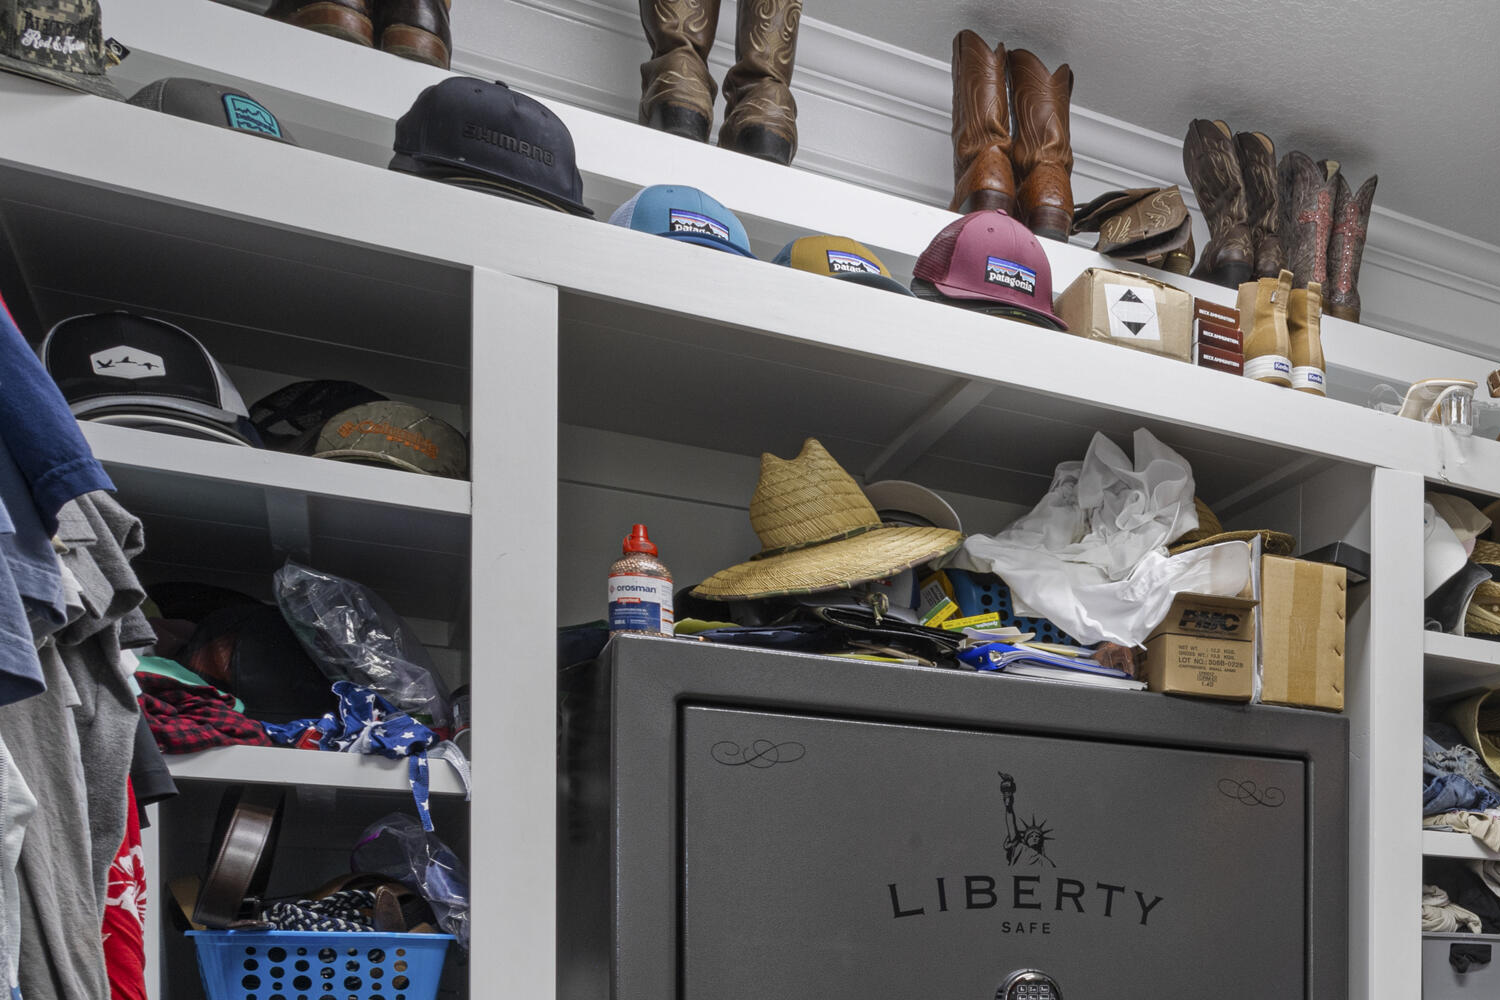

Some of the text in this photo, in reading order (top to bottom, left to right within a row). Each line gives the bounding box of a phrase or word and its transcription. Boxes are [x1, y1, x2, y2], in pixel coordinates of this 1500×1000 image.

[463, 121, 555, 167] SHIMANO
[989, 272, 1033, 292] patagonia
[888, 875, 1164, 926] LIBERTY
[1001, 921, 1051, 934] SAFE
